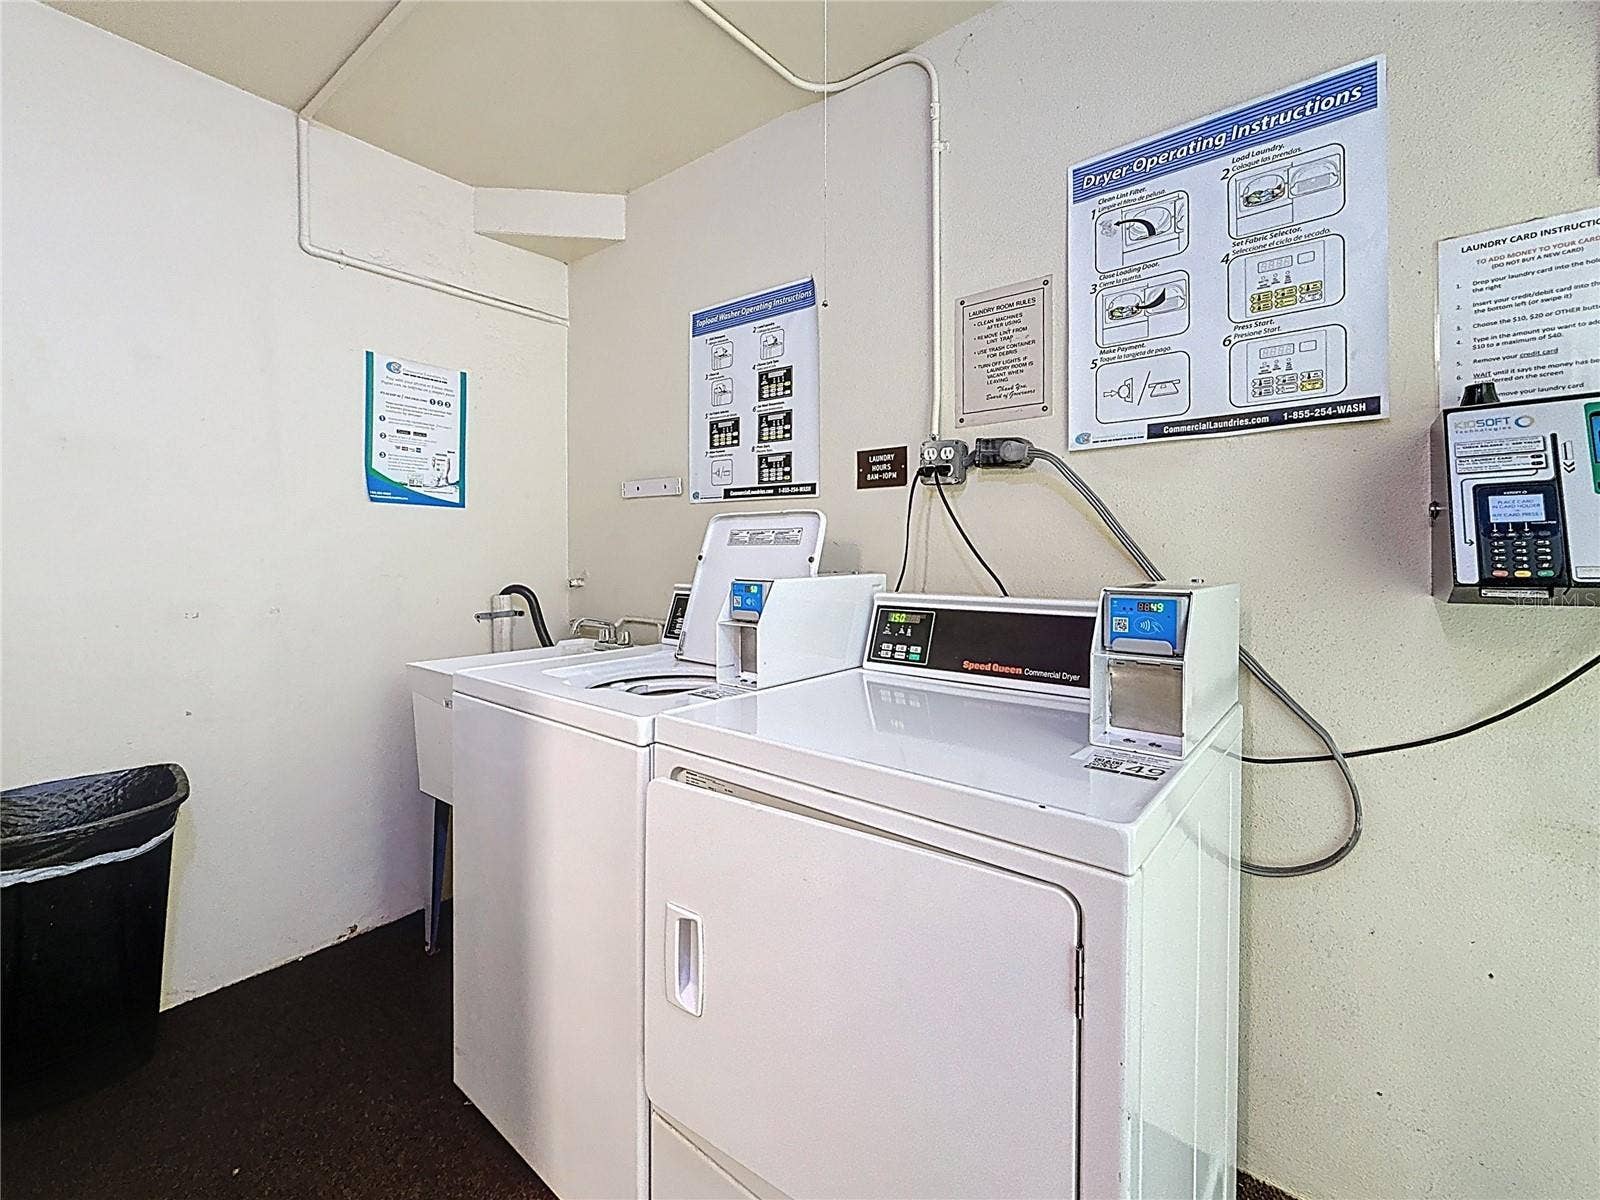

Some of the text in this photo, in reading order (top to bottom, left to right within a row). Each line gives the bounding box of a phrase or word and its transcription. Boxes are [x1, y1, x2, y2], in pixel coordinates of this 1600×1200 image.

[1082, 84, 1363, 189] Dryer Operating Instructions
[1231, 143, 1285, 164] Load Laundry.
[1220, 168, 1230, 181] 2
[1098, 195, 1116, 205] Clean
[1116, 191, 1130, 200] Lint
[1091, 209, 1097, 220] 1
[1231, 226, 1303, 248] Set Fabric Selector.
[1461, 236, 1509, 254] LAUNDRY
[1509, 231, 1538, 244] CARD
[1231, 243, 1268, 256] Seleccione
[1488, 254, 1506, 263] ADD
[1506, 248, 1538, 259] MONEY
[1539, 245, 1551, 253] TO
[1552, 240, 1577, 251] YOUR
[1220, 253, 1230, 265] 4
[1505, 259, 1521, 267] NOT
[1521, 256, 1536, 264] BUY
[1543, 251, 1562, 259] NEW
[1561, 246, 1585, 255] CARD)
[1098, 272, 1116, 281] Close
[1116, 267, 1142, 277] Loading
[1490, 275, 1508, 283] your
[1508, 270, 1536, 280] laundry
[1536, 267, 1553, 275] card
[1089, 283, 1098, 295] 3
[1484, 283, 1502, 292] right
[1472, 300, 1493, 309] Insert
[1493, 297, 1510, 305] your
[1510, 288, 1554, 302] credit/debit
[1554, 285, 1573, 293] card
[696, 289, 813, 328] Topload Washer Operating Instructions
[968, 296, 1037, 318] LAUNDRY ROOM RULES
[1487, 303, 1514, 313] bottom
[1540, 295, 1563, 304] swipe
[977, 312, 1023, 327] CLEAN MACHINES
[1004, 318, 1022, 327] USING
[1472, 320, 1499, 330] Choose
[1499, 318, 1512, 326] the
[1554, 306, 1581, 316] OTHER
[1233, 319, 1275, 332] Press Start.
[977, 332, 999, 340] REMOVE
[1012, 326, 1028, 334] FROM
[1233, 330, 1263, 340] Presione
[1473, 336, 1490, 344] Type
[1511, 328, 1541, 338] amount
[1541, 327, 1556, 335] you
[1556, 323, 1577, 331] want
[1222, 334, 1232, 347] 6
[1501, 336, 1537, 346] maximum
[977, 339, 1036, 356] USE TRASH CONTAINER
[998, 348, 1018, 357] DEBRIS
[1099, 347, 1117, 356] Make
[1001, 357, 1022, 366] LIGHTS
[1472, 347, 1559, 365] Remove your credit card
[986, 362, 1028, 374] LAUNDRY ROOM
[1090, 358, 1099, 370] 5
[1473, 371, 1493, 379] WAIT
[1492, 368, 1509, 376] until
[1517, 365, 1533, 374] says
[1547, 361, 1574, 370] money
[986, 368, 1025, 380] VACANT WHEN
[1538, 369, 1564, 377] screen
[986, 377, 1009, 385] LEAVING
[1519, 382, 1585, 396] your laundry card
[1162, 402, 1367, 435] CommercialLaundries.com 1-855-254-WASH
[868, 453, 896, 463] LAUNDRY
[871, 463, 892, 472] HOURS
[866, 471, 898, 481] 8AM-10PM
[962, 660, 1081, 682] Speed Queen Commercial Dryer
[1125, 765, 1166, 777] 49
